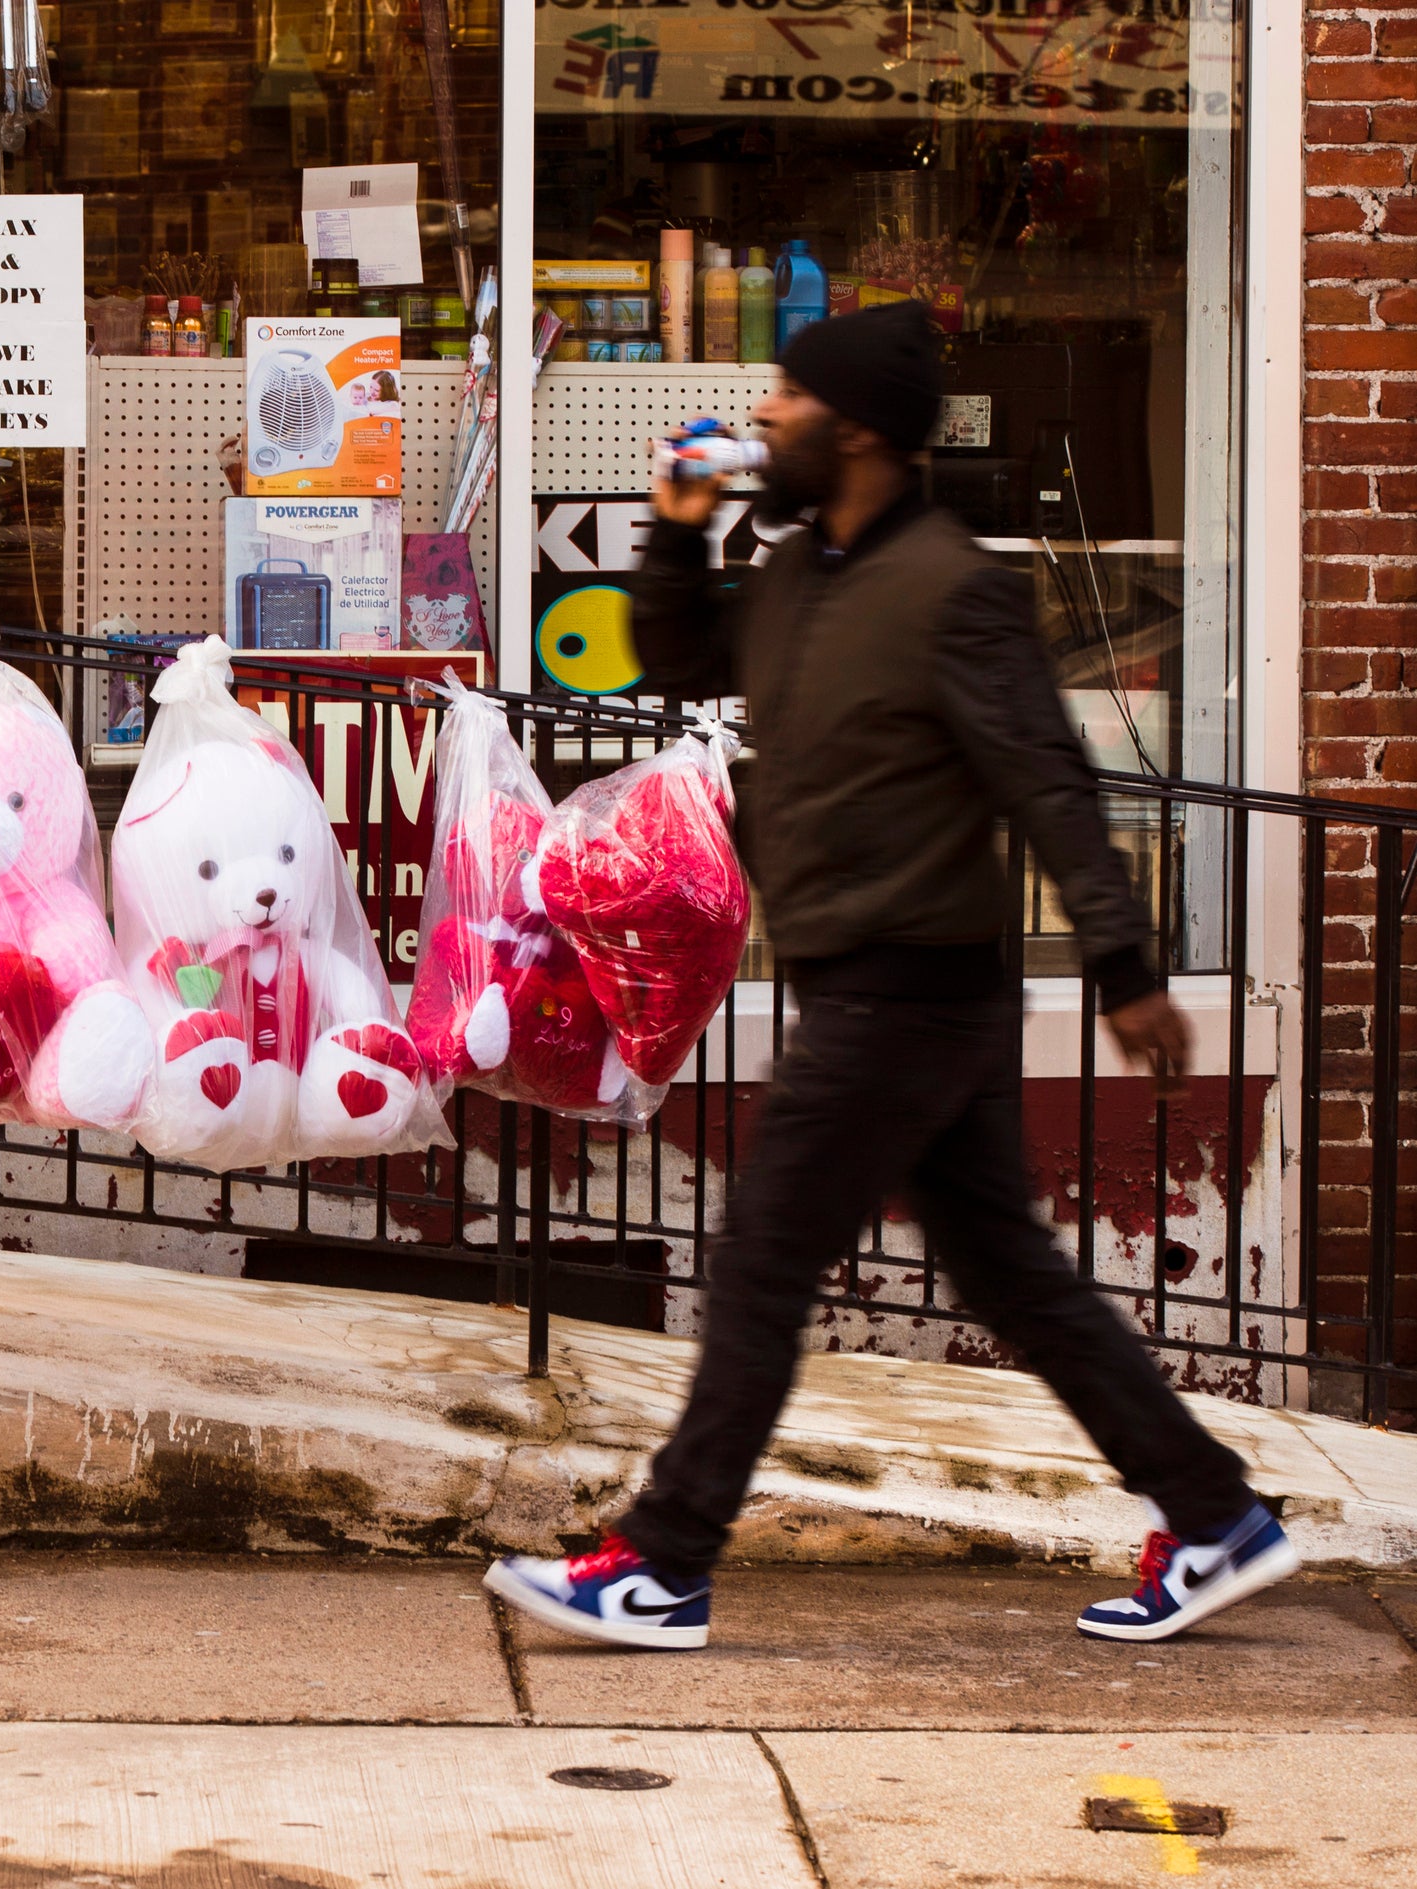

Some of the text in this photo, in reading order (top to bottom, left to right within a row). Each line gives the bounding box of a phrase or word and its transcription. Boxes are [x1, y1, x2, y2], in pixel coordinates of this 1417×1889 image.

[0, 253, 21, 270] &
[939, 292, 957, 306] 36
[275, 325, 344, 337] Comfort Zone
[362, 348, 394, 358] Compact
[354, 356, 394, 365] Heater/Fan
[265, 505, 359, 519] POWERGEAR
[341, 575, 389, 586] Calefactor
[345, 587, 386, 598] Electrico
[340, 598, 390, 609] de Utilidad
[433, 606, 461, 623] Love
[425, 622, 453, 642] You
[256, 701, 437, 826] TM
